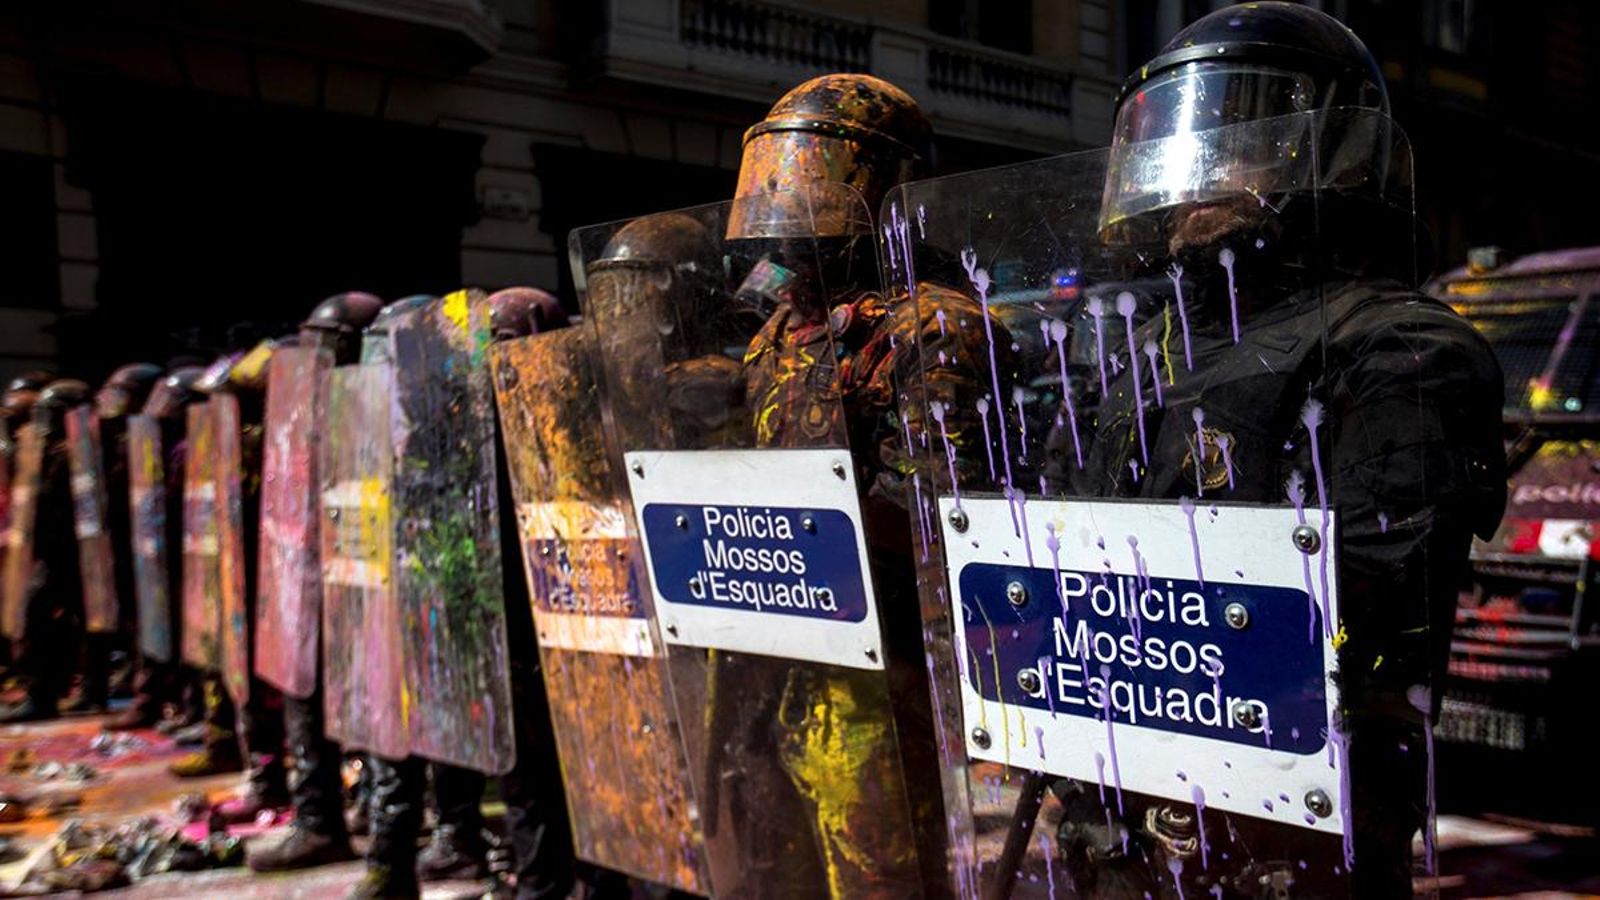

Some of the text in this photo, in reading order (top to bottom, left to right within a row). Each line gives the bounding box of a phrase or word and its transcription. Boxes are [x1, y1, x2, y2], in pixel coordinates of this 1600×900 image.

[703, 507, 794, 540] Policia
[703, 539, 806, 574] Mossos
[690, 571, 838, 611] d'Esquadra
[1060, 571, 1209, 627] Policia
[1053, 617, 1226, 678] Mossos
[1029, 657, 1273, 735] d'Esquadra
